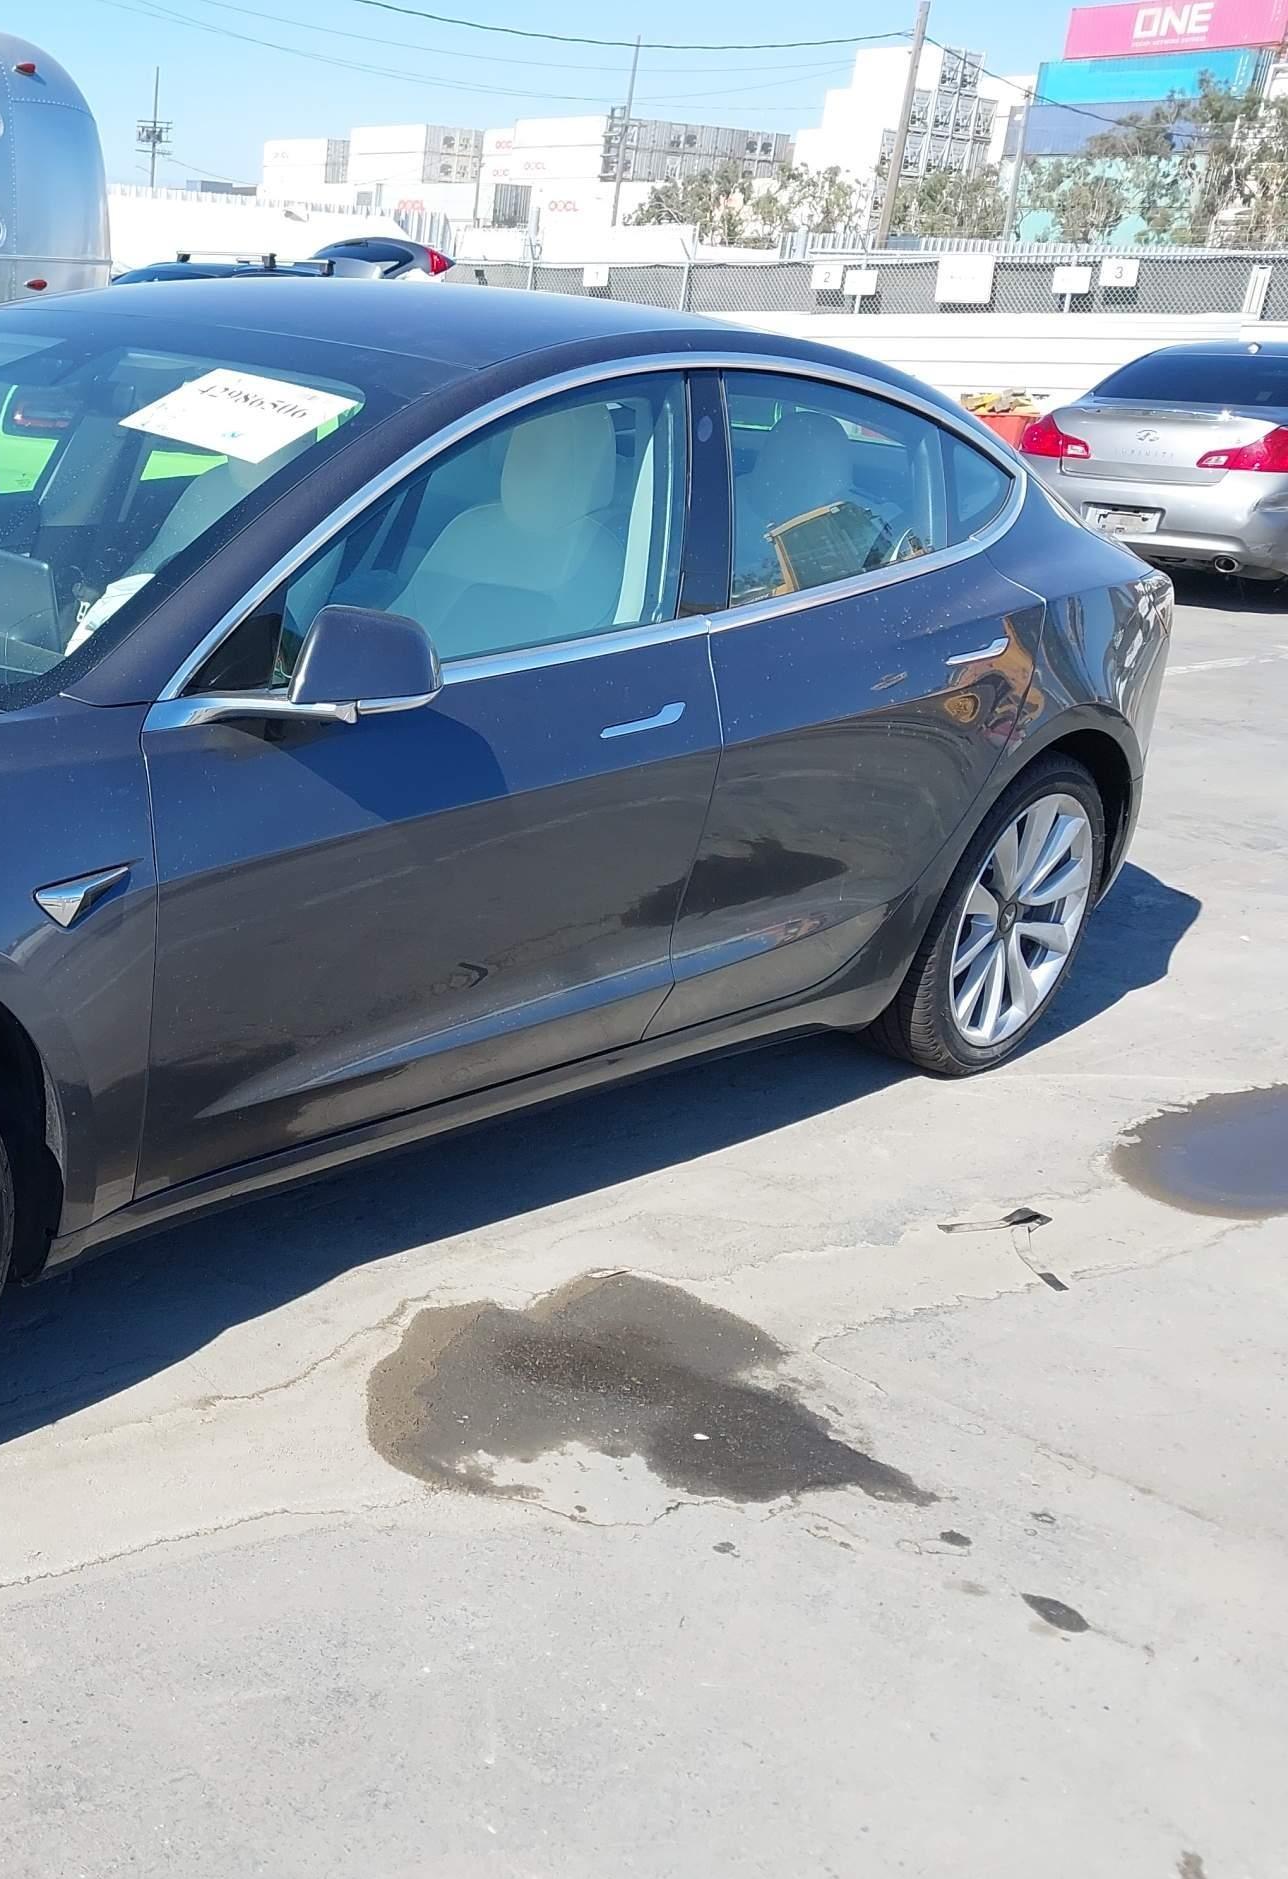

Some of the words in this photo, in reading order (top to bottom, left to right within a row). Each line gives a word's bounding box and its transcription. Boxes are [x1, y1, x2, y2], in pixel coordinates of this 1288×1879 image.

[1132, 2, 1215, 39] ONE
[548, 200, 580, 212] OOCL
[823, 271, 831, 283] 2
[1114, 266, 1124, 279] 3
